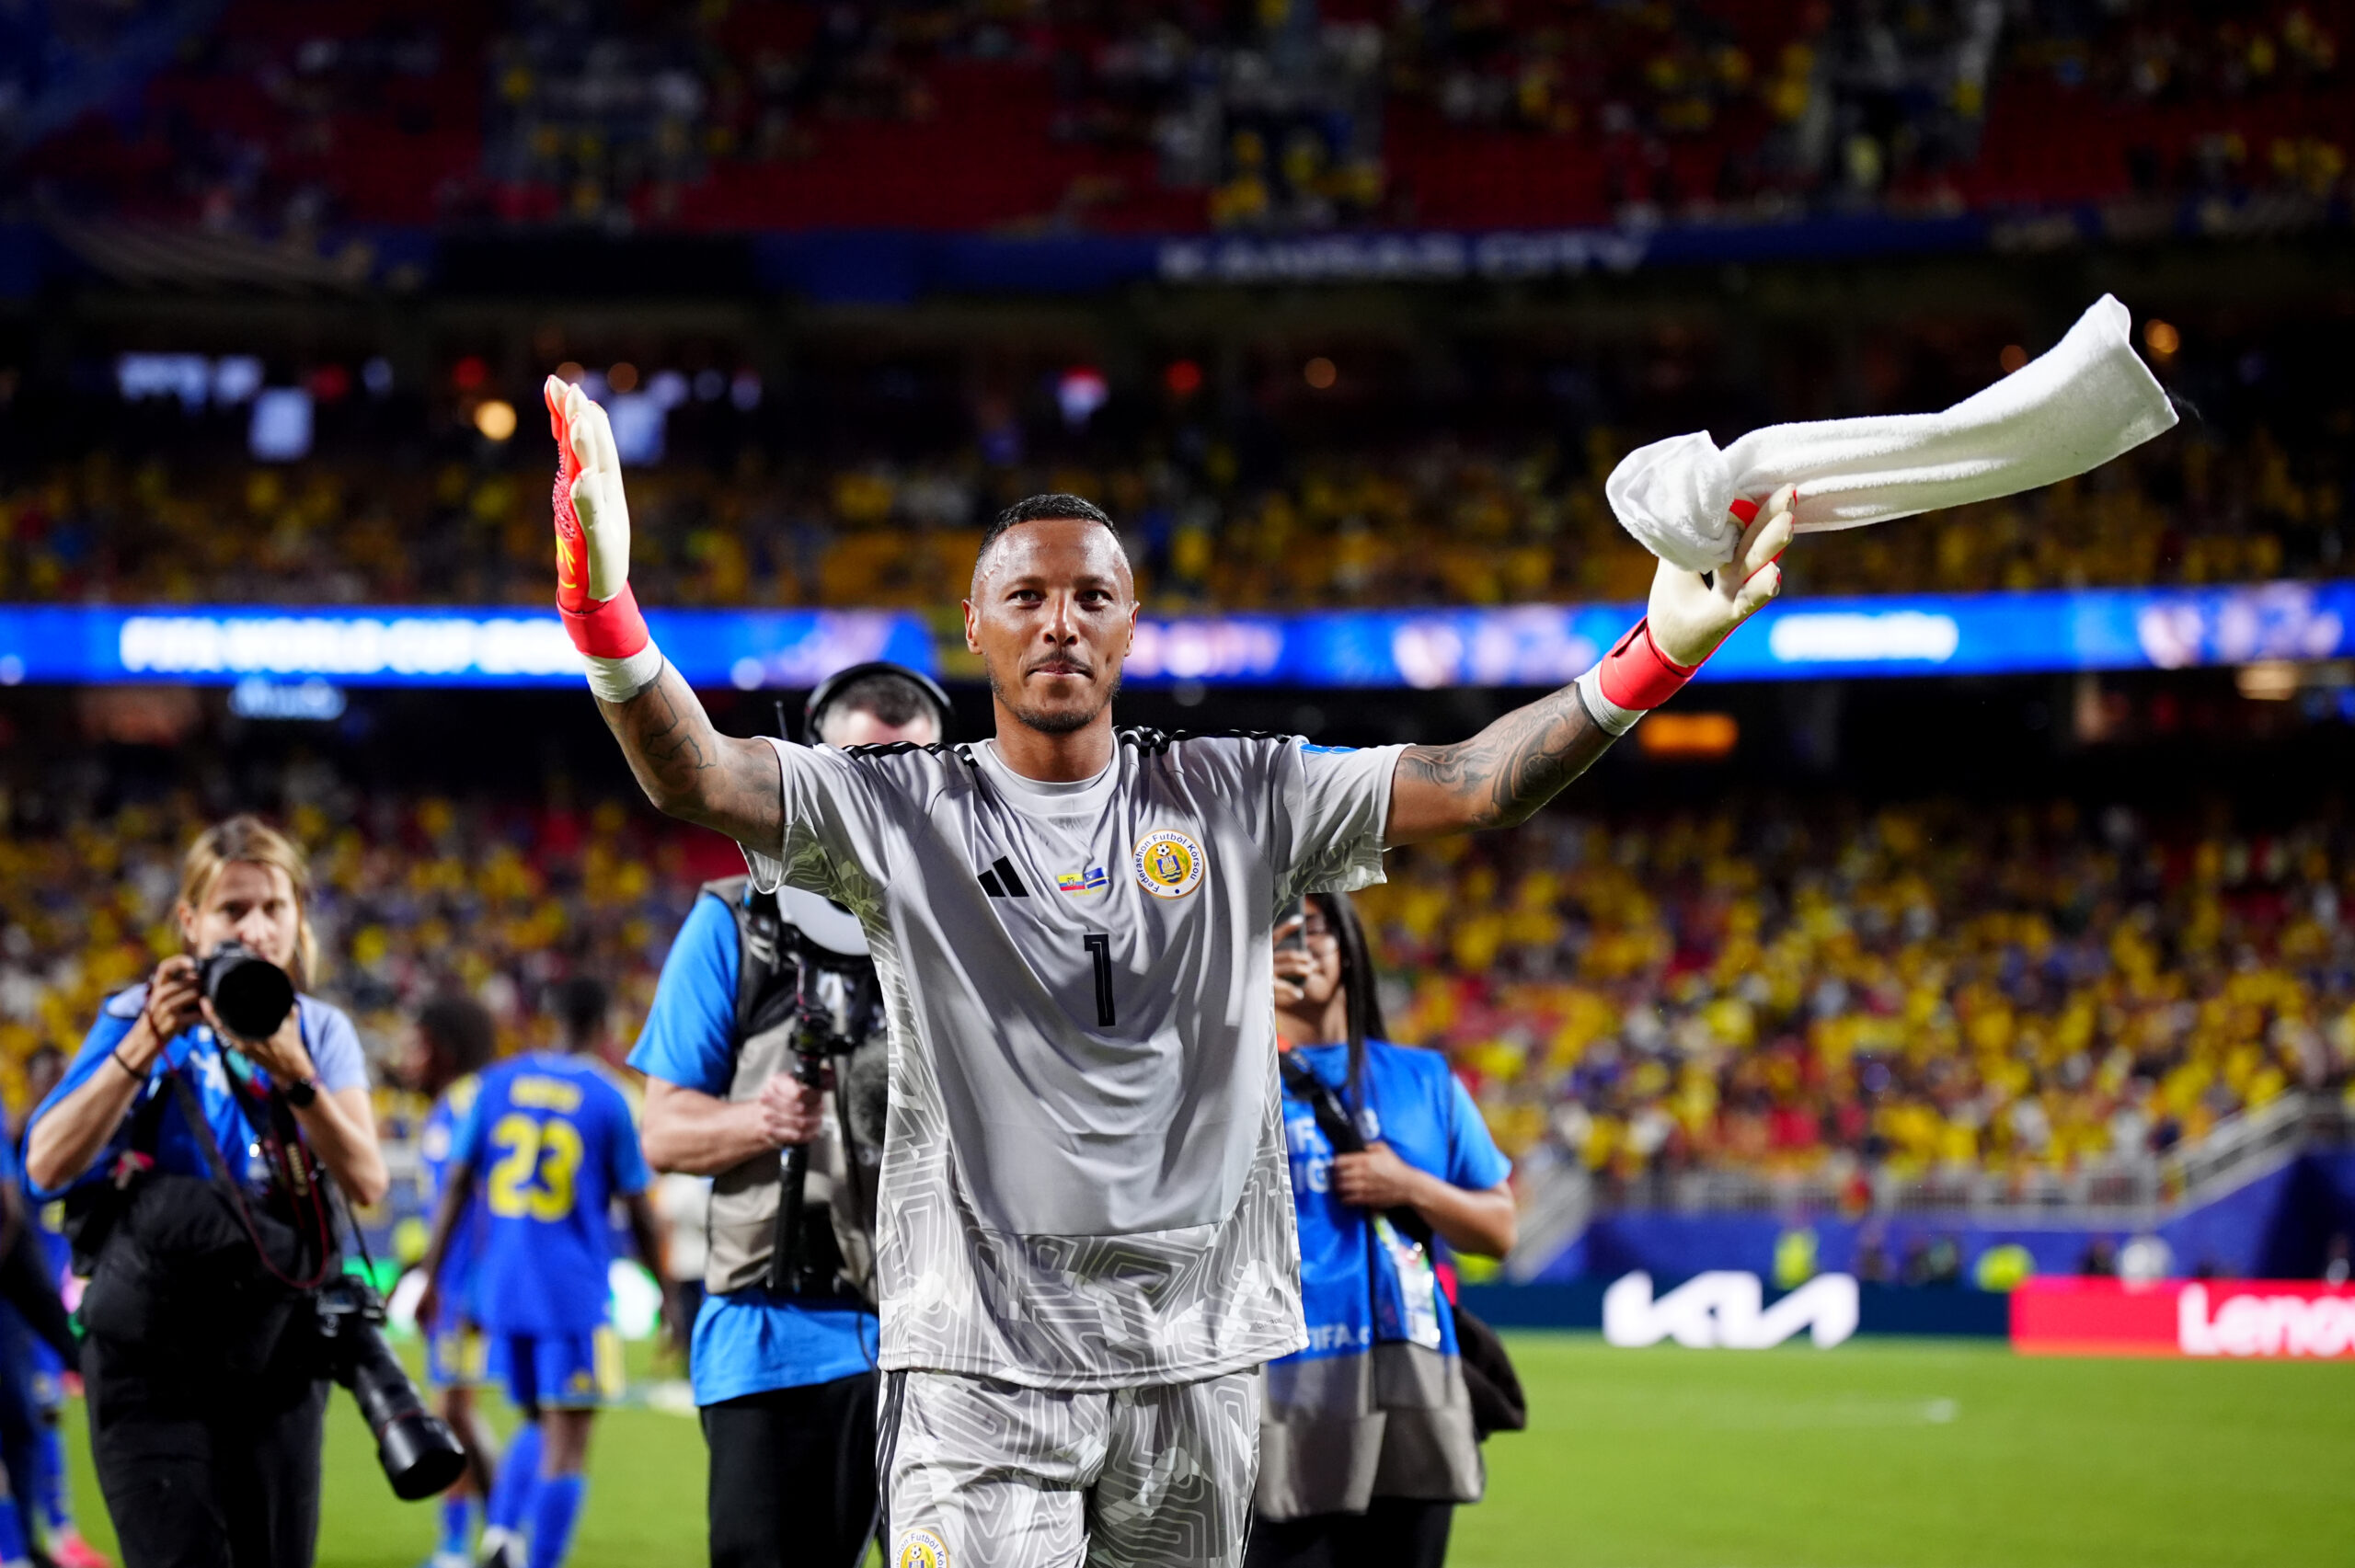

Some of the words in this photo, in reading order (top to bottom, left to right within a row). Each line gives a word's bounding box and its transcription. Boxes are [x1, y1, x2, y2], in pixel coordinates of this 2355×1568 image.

[1136, 841, 1160, 893] Federashon
[1084, 934, 1116, 1026] 1
[489, 1113, 583, 1221] 23
[1602, 1270, 1859, 1349] KIA
[2177, 1282, 2355, 1356] Leno
